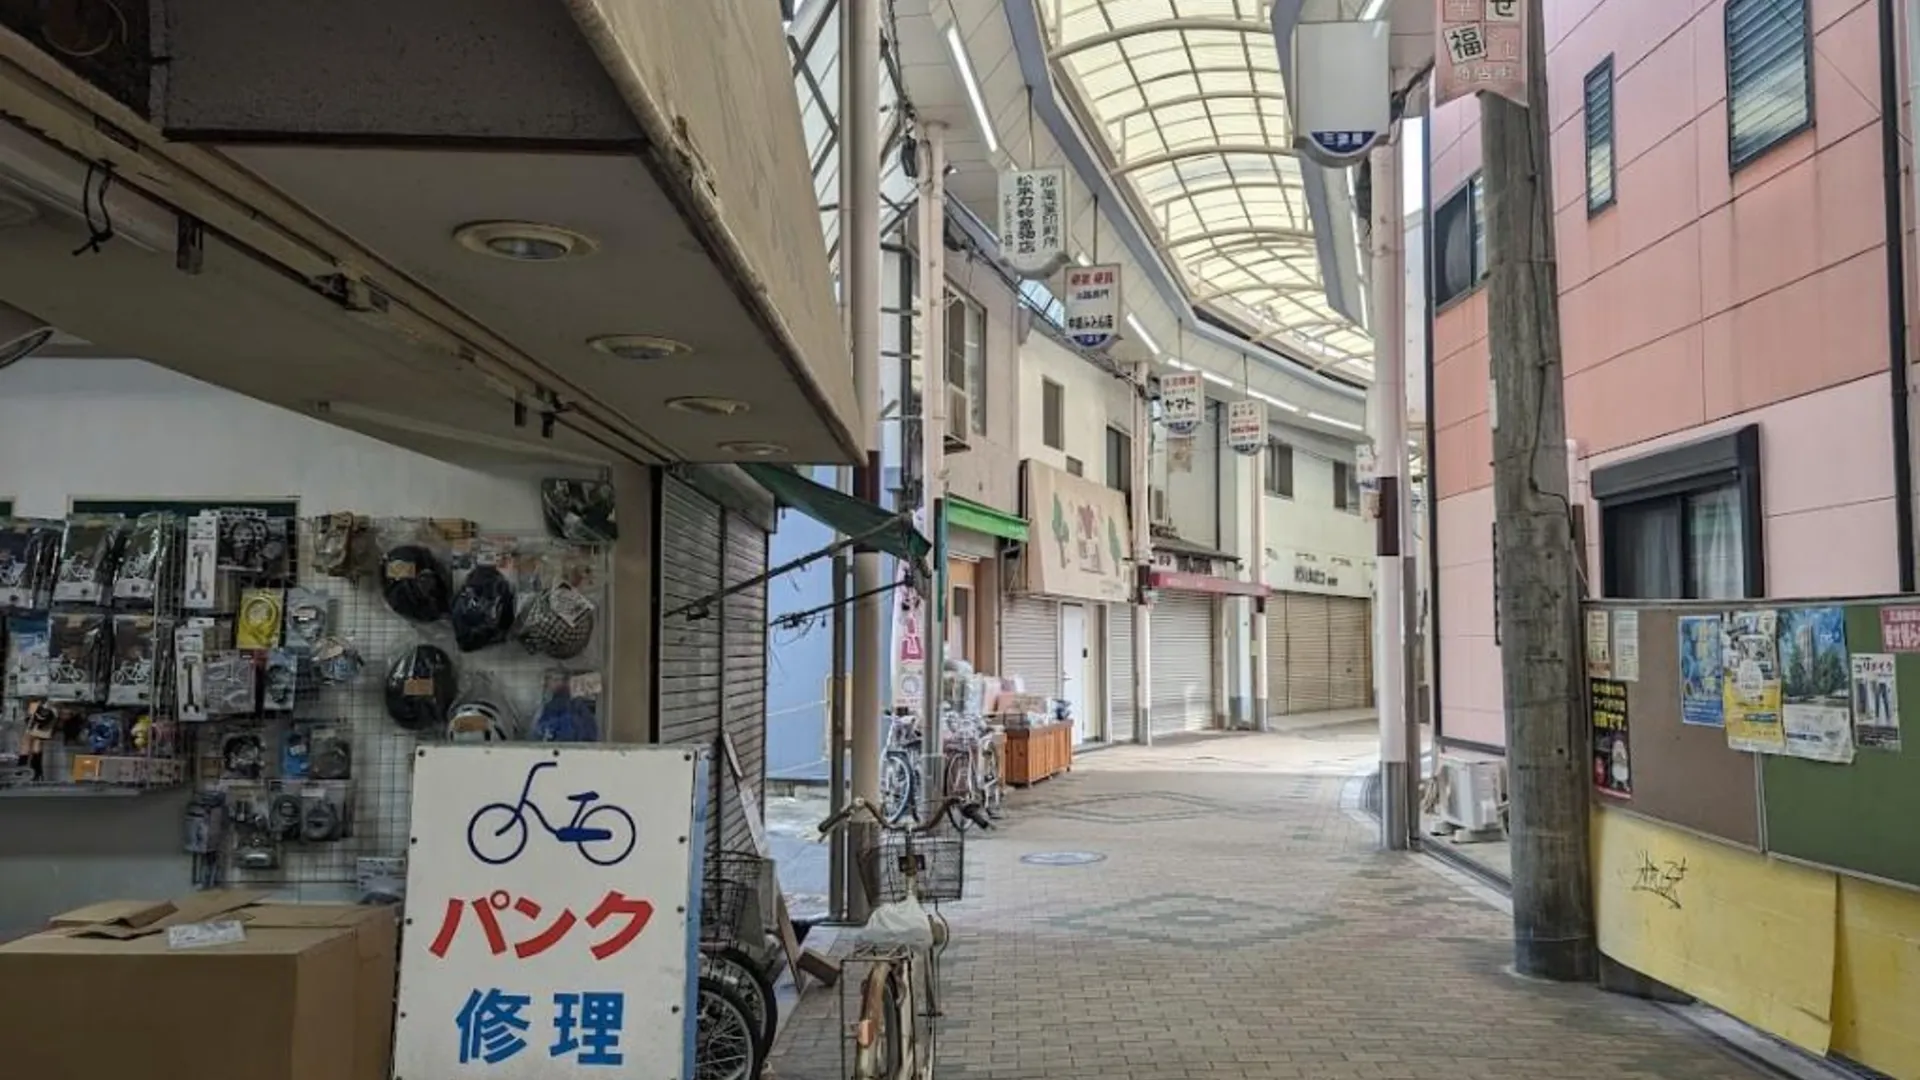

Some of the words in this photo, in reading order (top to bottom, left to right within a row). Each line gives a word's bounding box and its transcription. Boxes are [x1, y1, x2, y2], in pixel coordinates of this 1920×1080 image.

[1450, 26, 1483, 59] 福
[1165, 397, 1196, 412] ヤマト
[428, 889, 654, 960] パンク
[455, 987, 624, 1066] 修理
